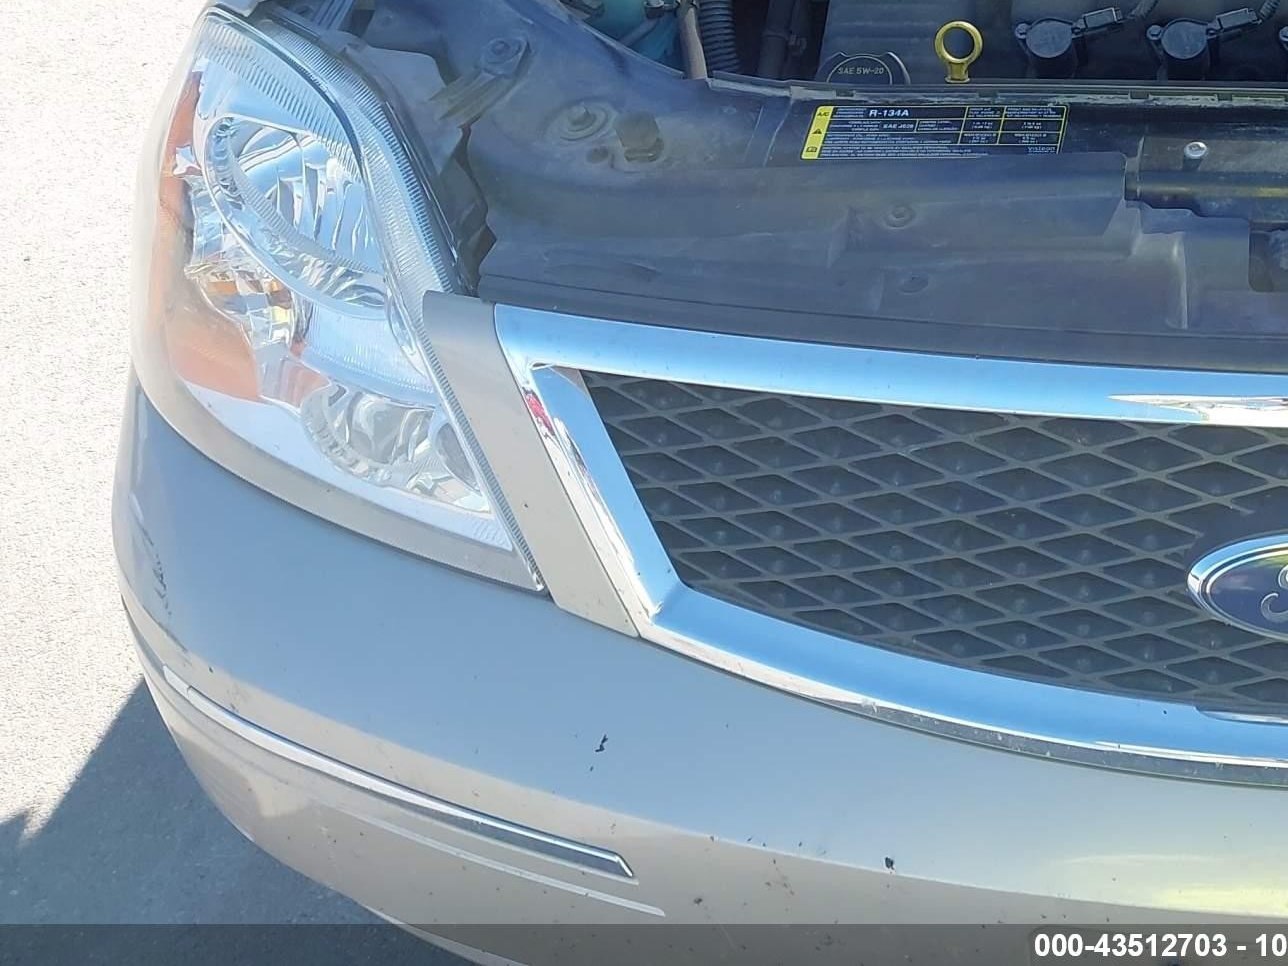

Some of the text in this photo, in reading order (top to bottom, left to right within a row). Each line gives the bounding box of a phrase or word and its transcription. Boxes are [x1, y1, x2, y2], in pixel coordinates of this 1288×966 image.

[837, 67, 884, 75] SAE 5W-20
[868, 109, 910, 117] R-134A
